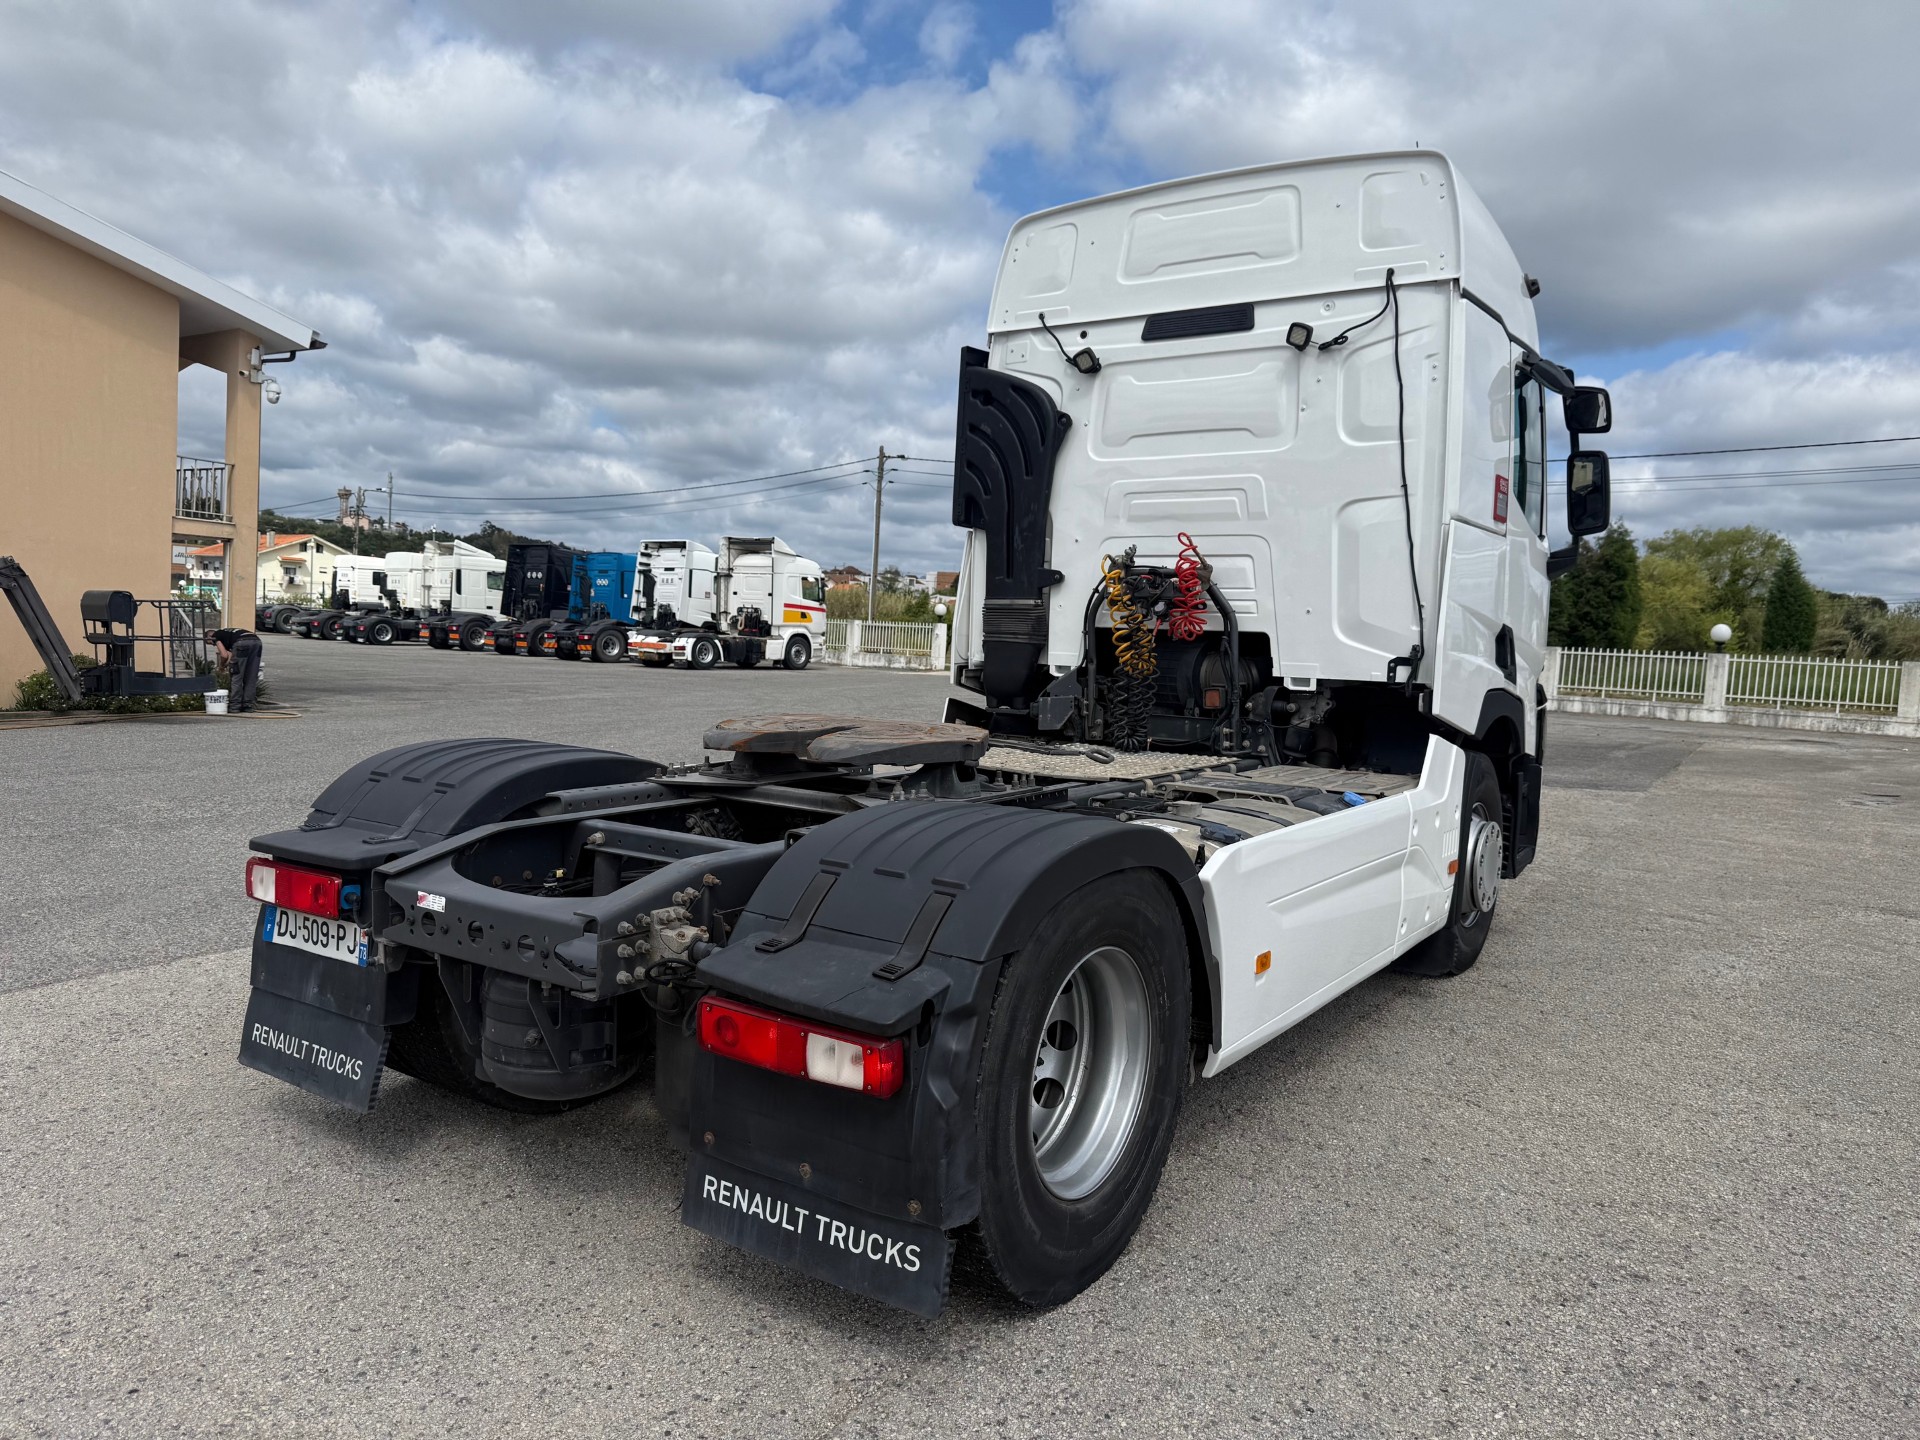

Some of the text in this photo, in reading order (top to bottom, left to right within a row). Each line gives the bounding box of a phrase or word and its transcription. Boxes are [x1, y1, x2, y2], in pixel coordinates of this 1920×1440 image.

[277, 909, 358, 955] DJ-509-PJ
[359, 946, 367, 960] 78
[252, 1023, 363, 1081] RENAULT TRUCKS
[703, 1174, 921, 1272] RENAULT TRUCKS
